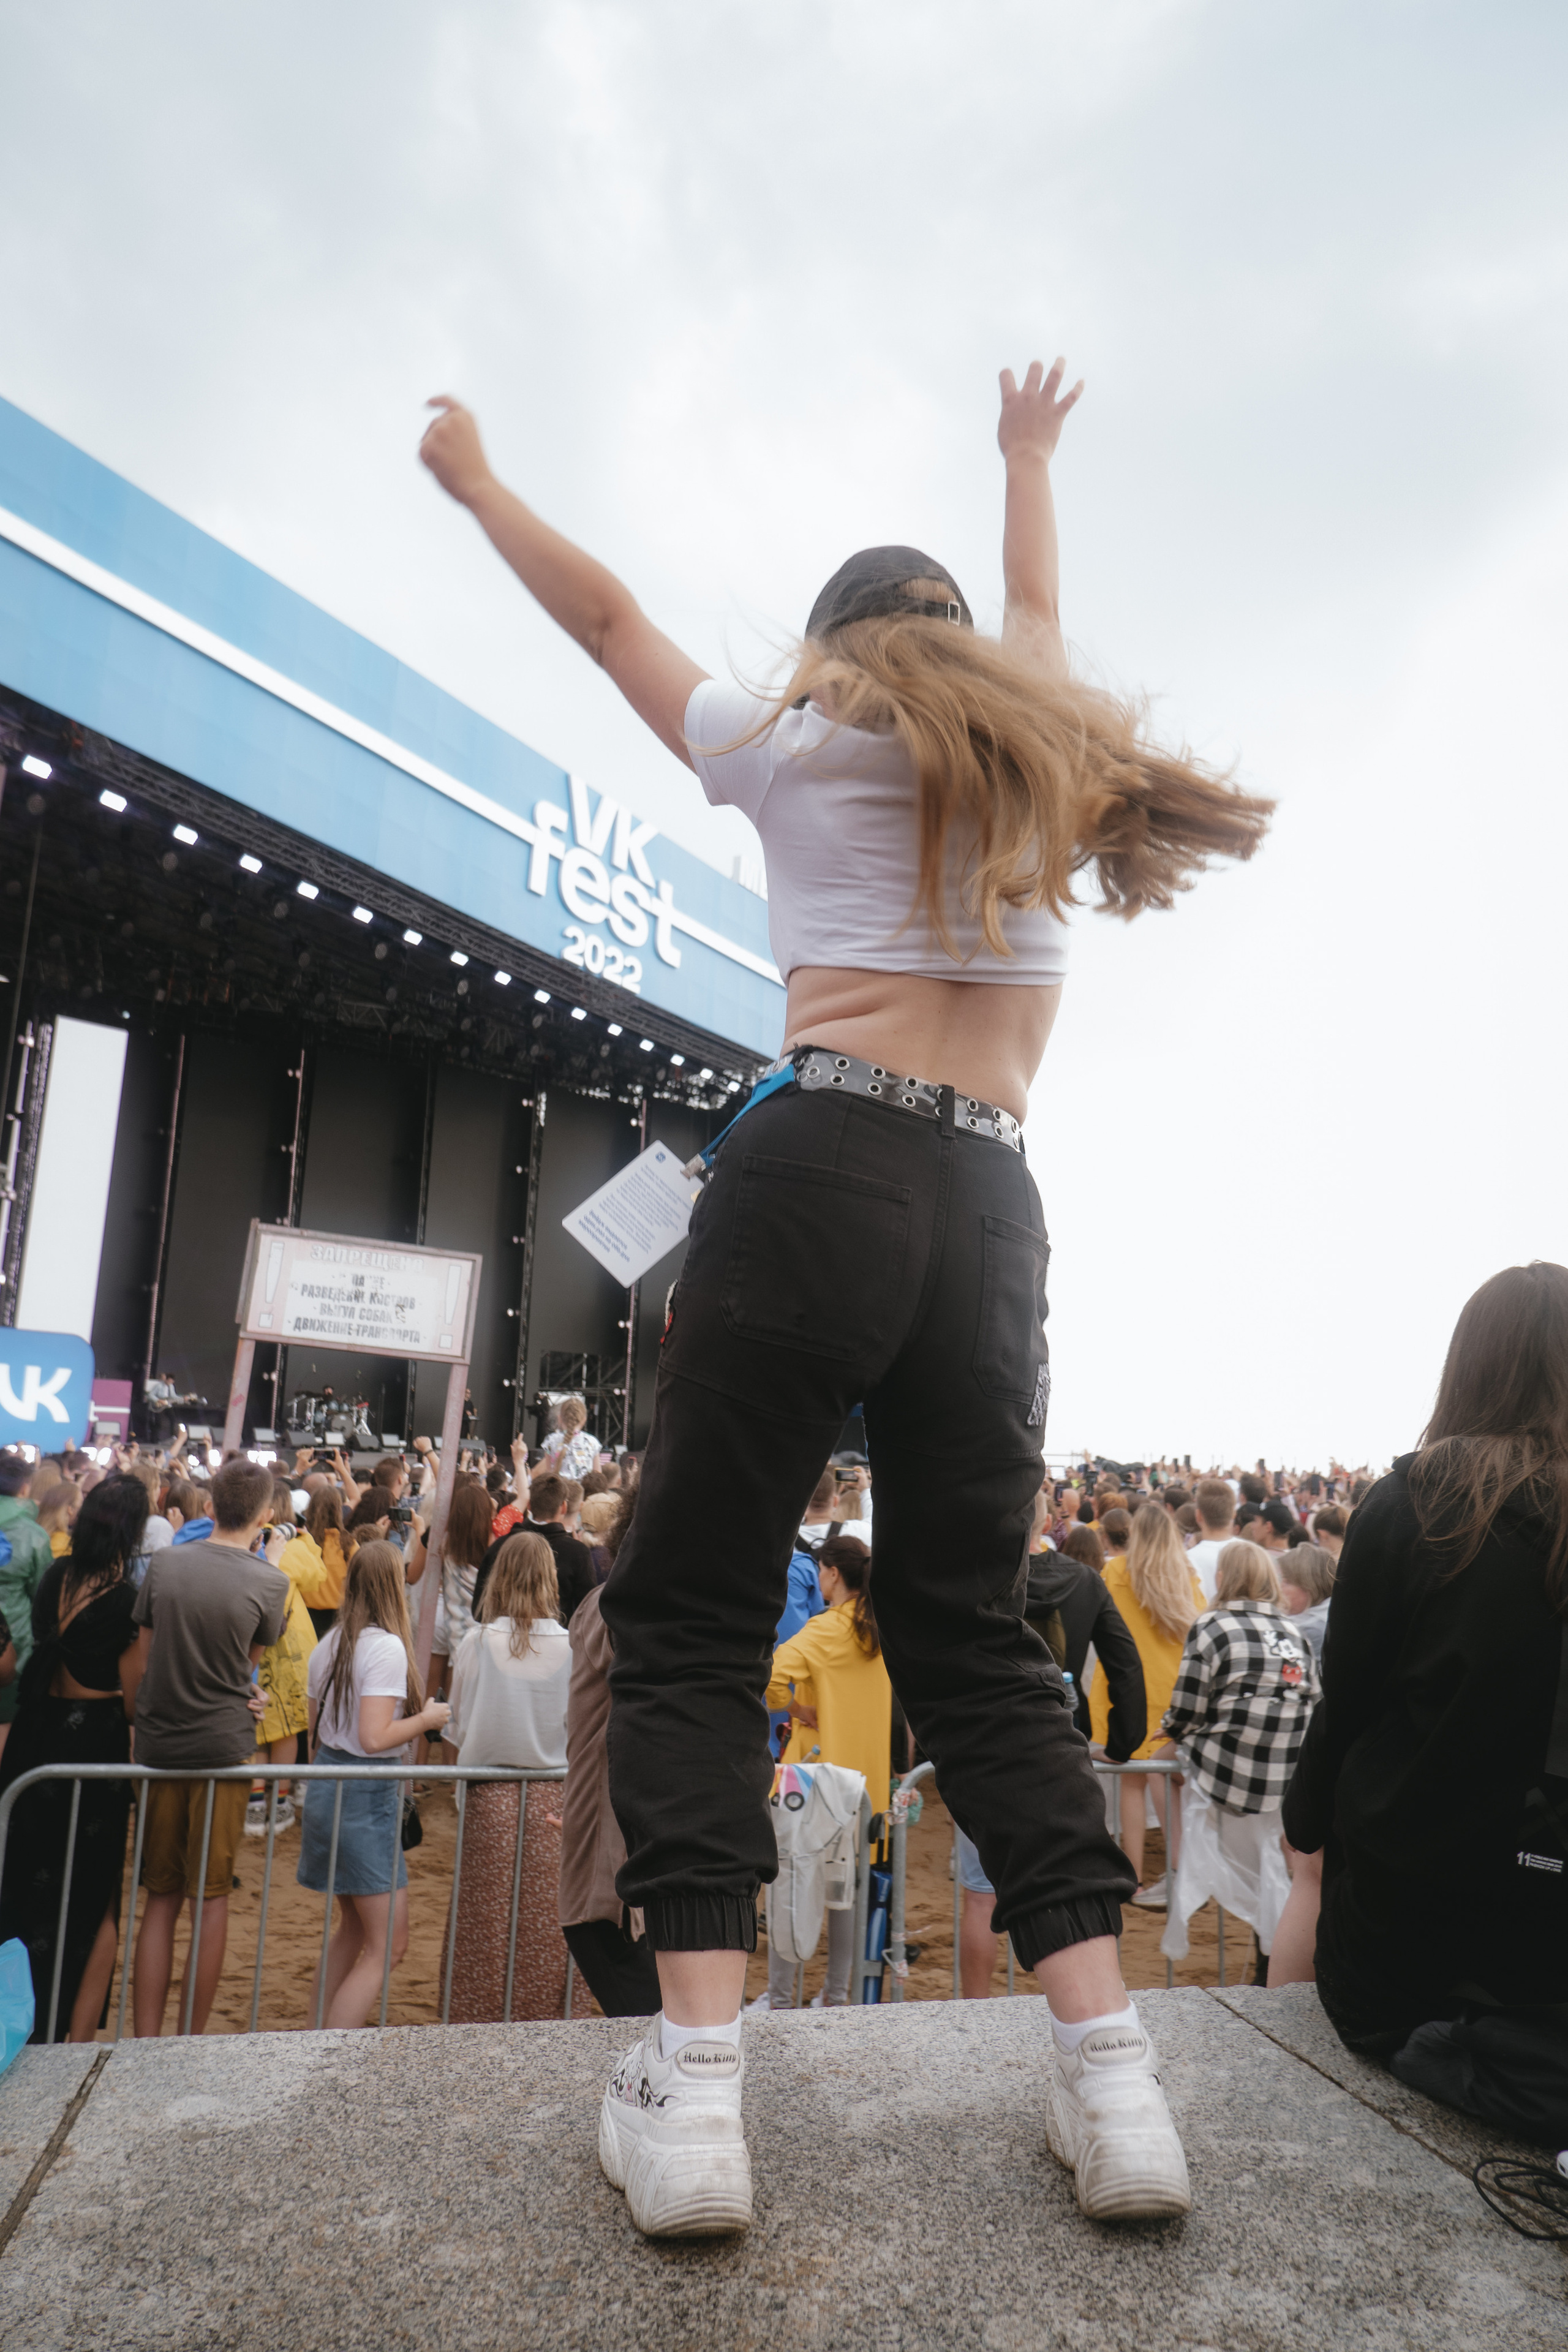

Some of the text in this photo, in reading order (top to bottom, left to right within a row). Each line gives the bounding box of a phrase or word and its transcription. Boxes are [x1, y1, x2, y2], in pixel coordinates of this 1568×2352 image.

[568, 773, 660, 889] VK
[527, 801, 682, 969] fest
[561, 925, 643, 995] 2022
[311, 1246, 424, 1271] ЗАПРЕЩЕНО
[684, 2051, 711, 2063] Hello
